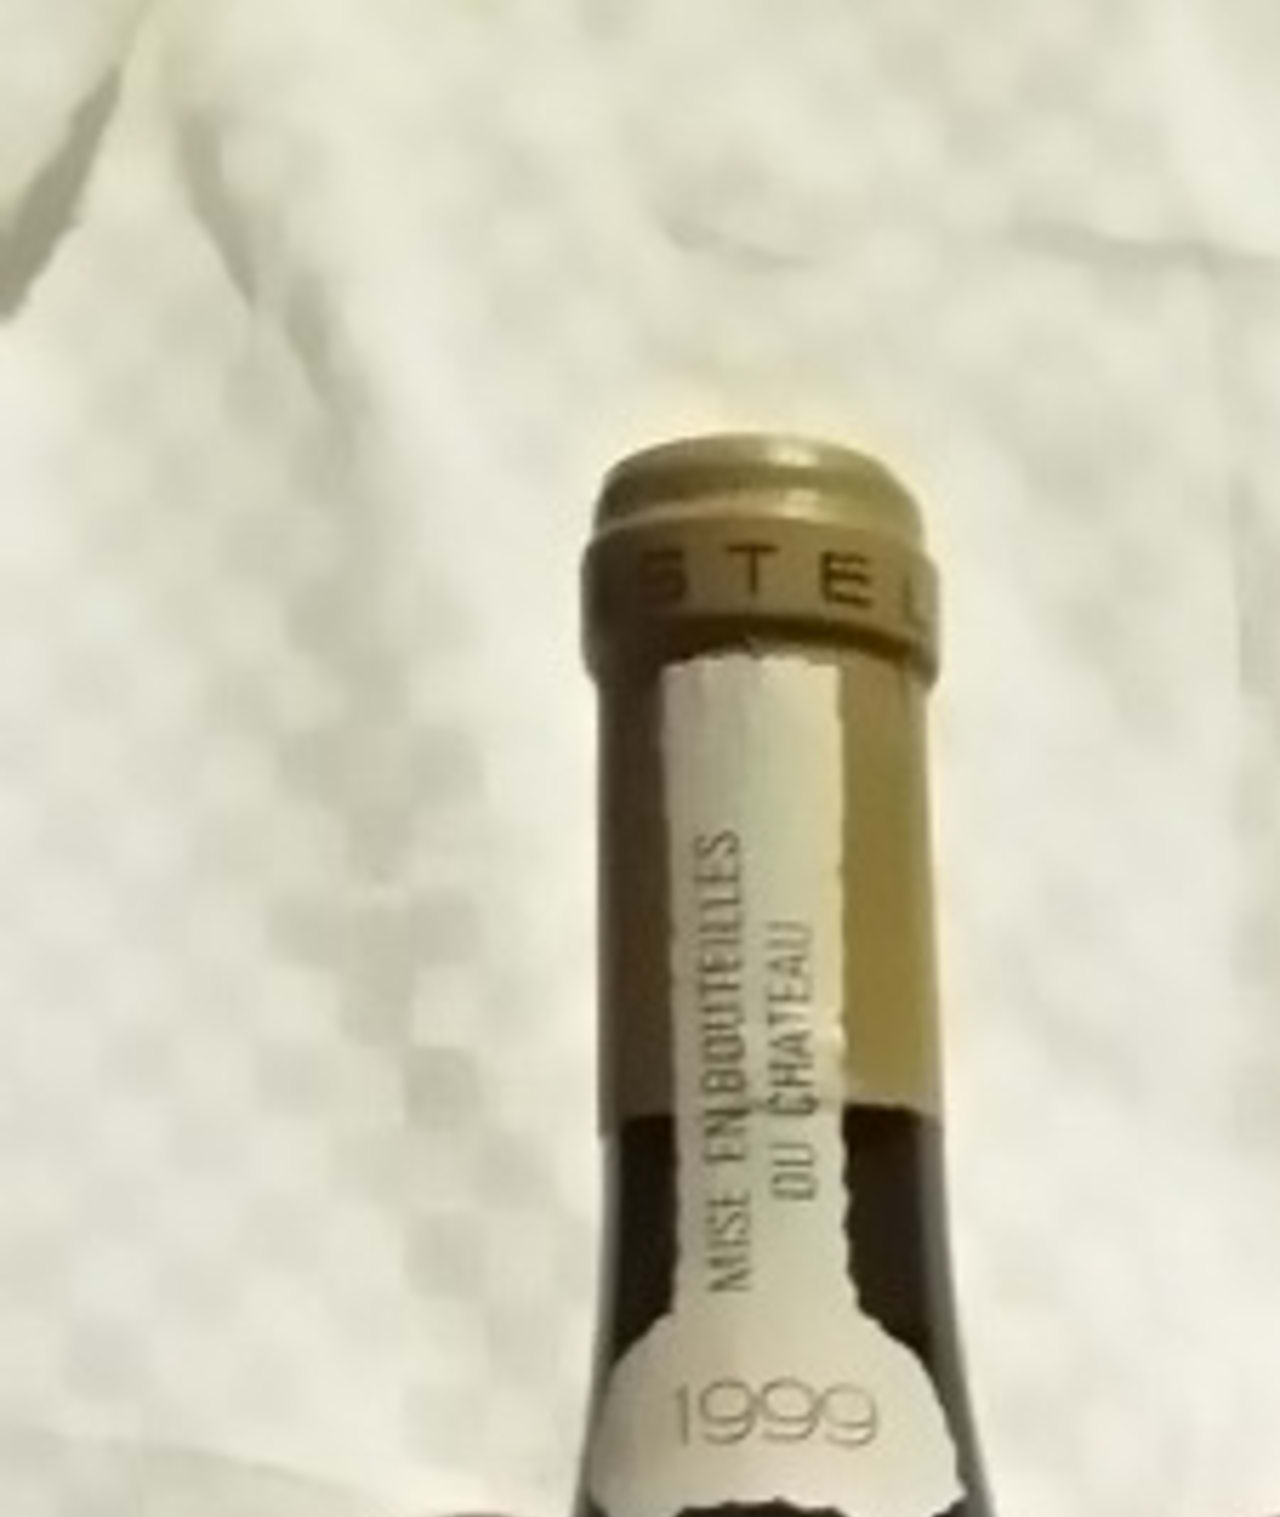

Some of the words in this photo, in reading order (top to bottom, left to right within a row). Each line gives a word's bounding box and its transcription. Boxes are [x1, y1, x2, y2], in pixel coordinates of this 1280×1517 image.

[694, 829, 749, 1104] BOUTEILLES
[703, 1110, 750, 1182] EN
[770, 1140, 820, 1202] DU
[705, 1187, 753, 1295] MISE
[674, 1376, 881, 1449] 1999
